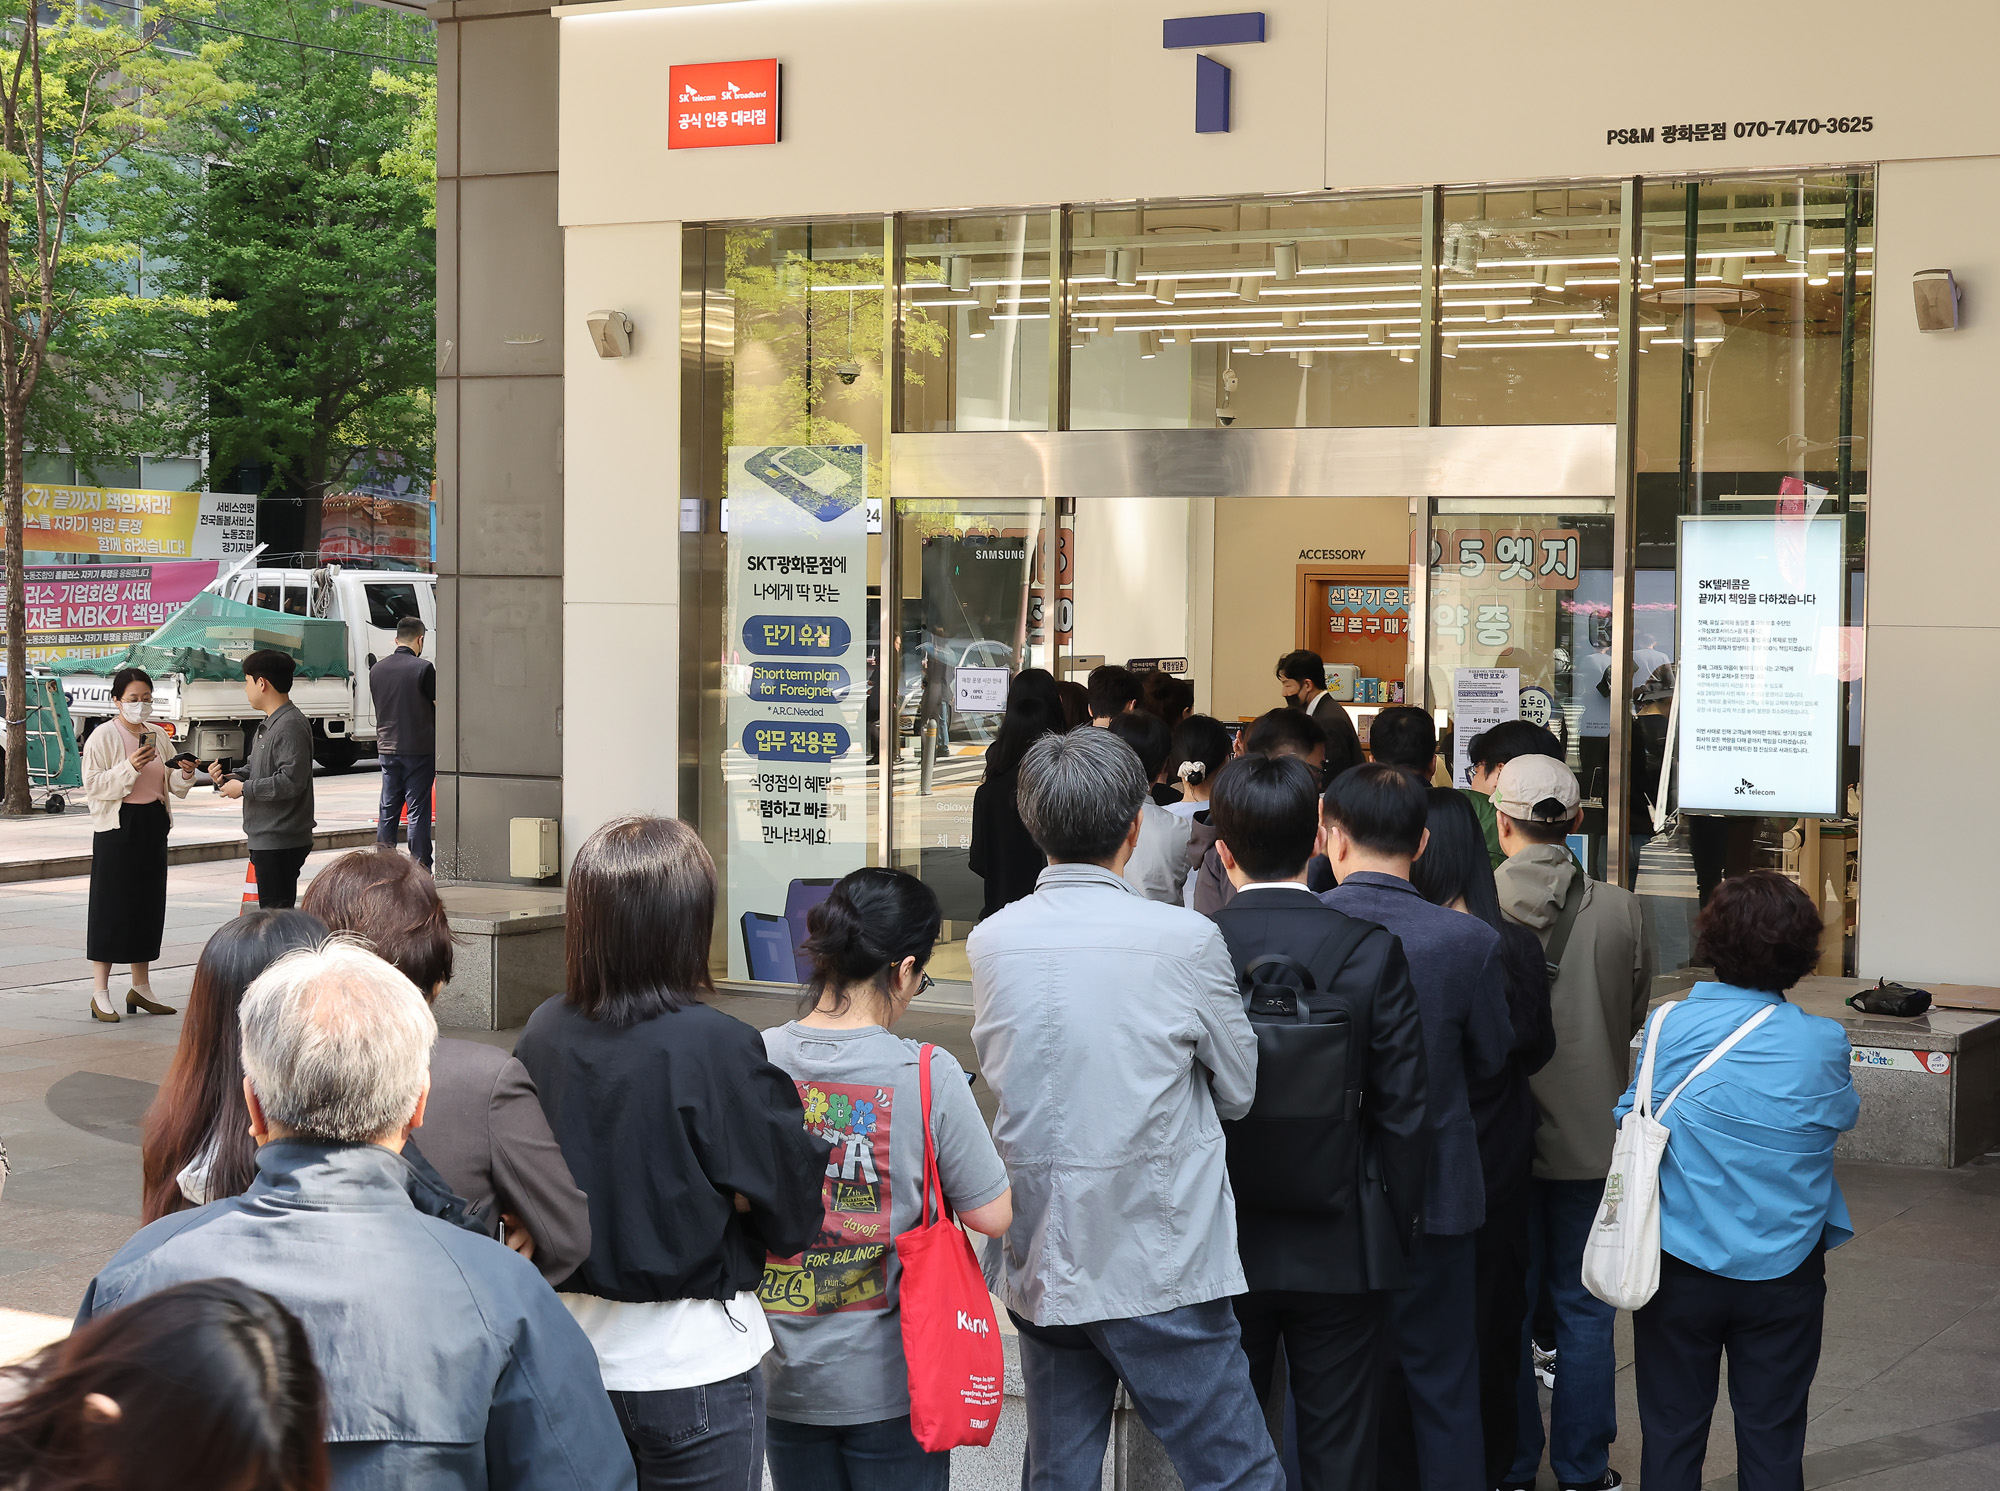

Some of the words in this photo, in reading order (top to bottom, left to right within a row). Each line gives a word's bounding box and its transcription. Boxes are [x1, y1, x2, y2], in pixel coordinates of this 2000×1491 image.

[1163, 12, 1265, 133] T
[679, 94, 690, 102] SK
[721, 91, 732, 100] SK
[734, 91, 766, 99] broadband
[678, 113, 701, 129] 공식
[704, 112, 728, 128] 인증
[732, 109, 766, 126] 대리점
[1607, 128, 1654, 144] PS&M
[1661, 122, 1726, 144] 광화문점
[1734, 116, 1873, 138] 070-7470-3625
[53, 490, 101, 512] 끝까지
[216, 502, 254, 514] 서비스연맹
[54, 515, 88, 532] 지키기
[92, 517, 116, 534] 위한
[118, 518, 142, 534] 투쟁
[222, 529, 254, 540] 노동조합
[98, 536, 122, 552] 함께
[124, 538, 186, 555] 하겠습니다!
[222, 542, 254, 553] 경기지부
[976, 550, 1025, 560] SAMSUNG
[1299, 550, 1366, 560] ACCESSORY
[748, 556, 846, 574] SKT광화문점에
[1698, 579, 1750, 590] SK텔레콤은
[60, 582, 119, 604] 기업회생
[122, 582, 151, 600] 사태
[754, 584, 793, 600] 나에게
[796, 584, 810, 602] 딱
[813, 584, 840, 602] 맞는
[1698, 594, 1726, 604] 끝까지
[1728, 594, 1756, 605] 책임을
[1760, 594, 1816, 605] 다하겠습니다
[67, 605, 128, 628] MBK가
[763, 624, 795, 646] 단기
[798, 624, 830, 648] 유심
[754, 668, 784, 680] Short
[786, 669, 812, 680] term
[814, 669, 840, 684] plan
[760, 683, 776, 694] for
[780, 684, 834, 699] Foreigner
[1520, 696, 1546, 708] 모두의
[1521, 710, 1544, 724] 매장
[755, 730, 786, 752] 업무
[790, 732, 838, 754] 전용폰
[1734, 786, 1745, 795] SK
[1749, 788, 1776, 796] telecom
[936, 802, 969, 813] Galaxy
[762, 826, 831, 845] 만나보세요!
[1868, 1056, 1893, 1066] Lotto
[846, 1187, 860, 1196] 7th
[843, 1218, 881, 1238] dayoff
[805, 1253, 831, 1268] FOR
[833, 1245, 884, 1265] BALANCE
